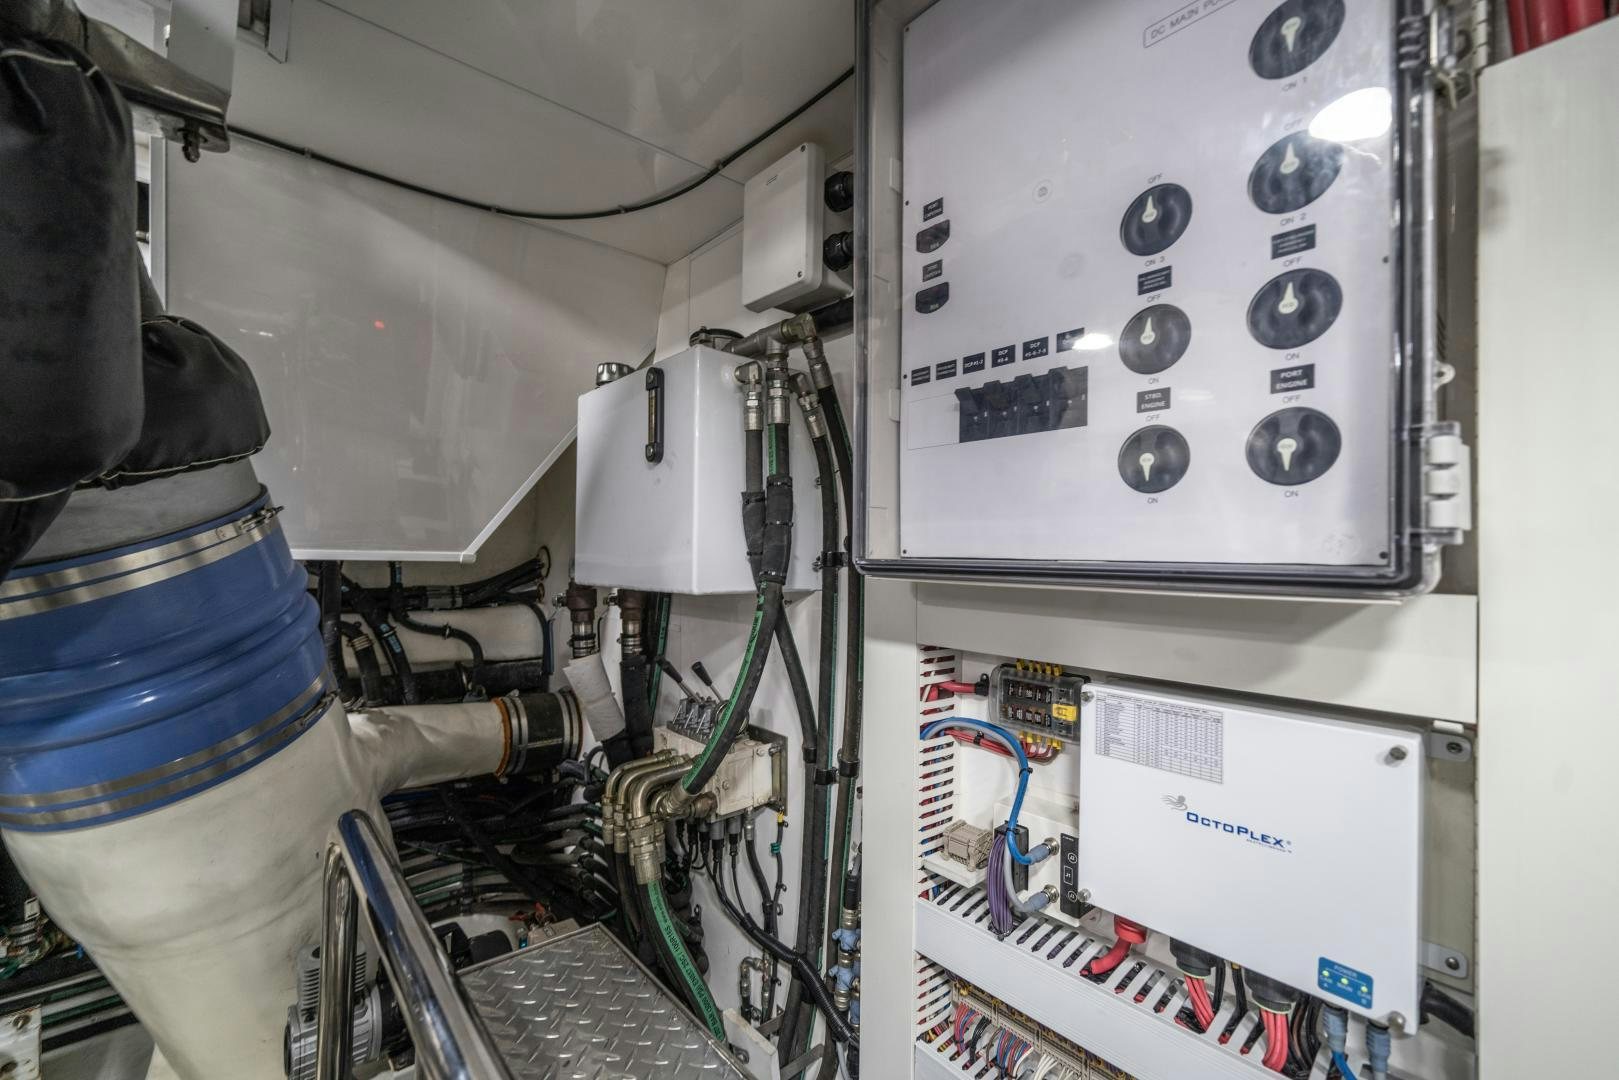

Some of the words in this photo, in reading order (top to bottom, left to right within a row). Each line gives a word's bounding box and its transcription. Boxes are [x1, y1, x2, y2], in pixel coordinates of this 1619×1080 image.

[1150, 24, 1166, 40] DC
[1147, 172, 1163, 184] OFF
[1280, 216, 1294, 226] ON
[1144, 259, 1156, 267] ON
[1282, 257, 1301, 268] OFF
[1146, 293, 1161, 303] OFF
[1284, 352, 1299, 361] ON
[1280, 369, 1303, 379] PORT
[1148, 377, 1160, 385] ON
[1275, 379, 1308, 390] ENGINE
[1281, 394, 1301, 404] OFF
[1141, 401, 1167, 410] ENGINE
[1145, 414, 1161, 422] OFF
[1284, 490, 1299, 498] ON
